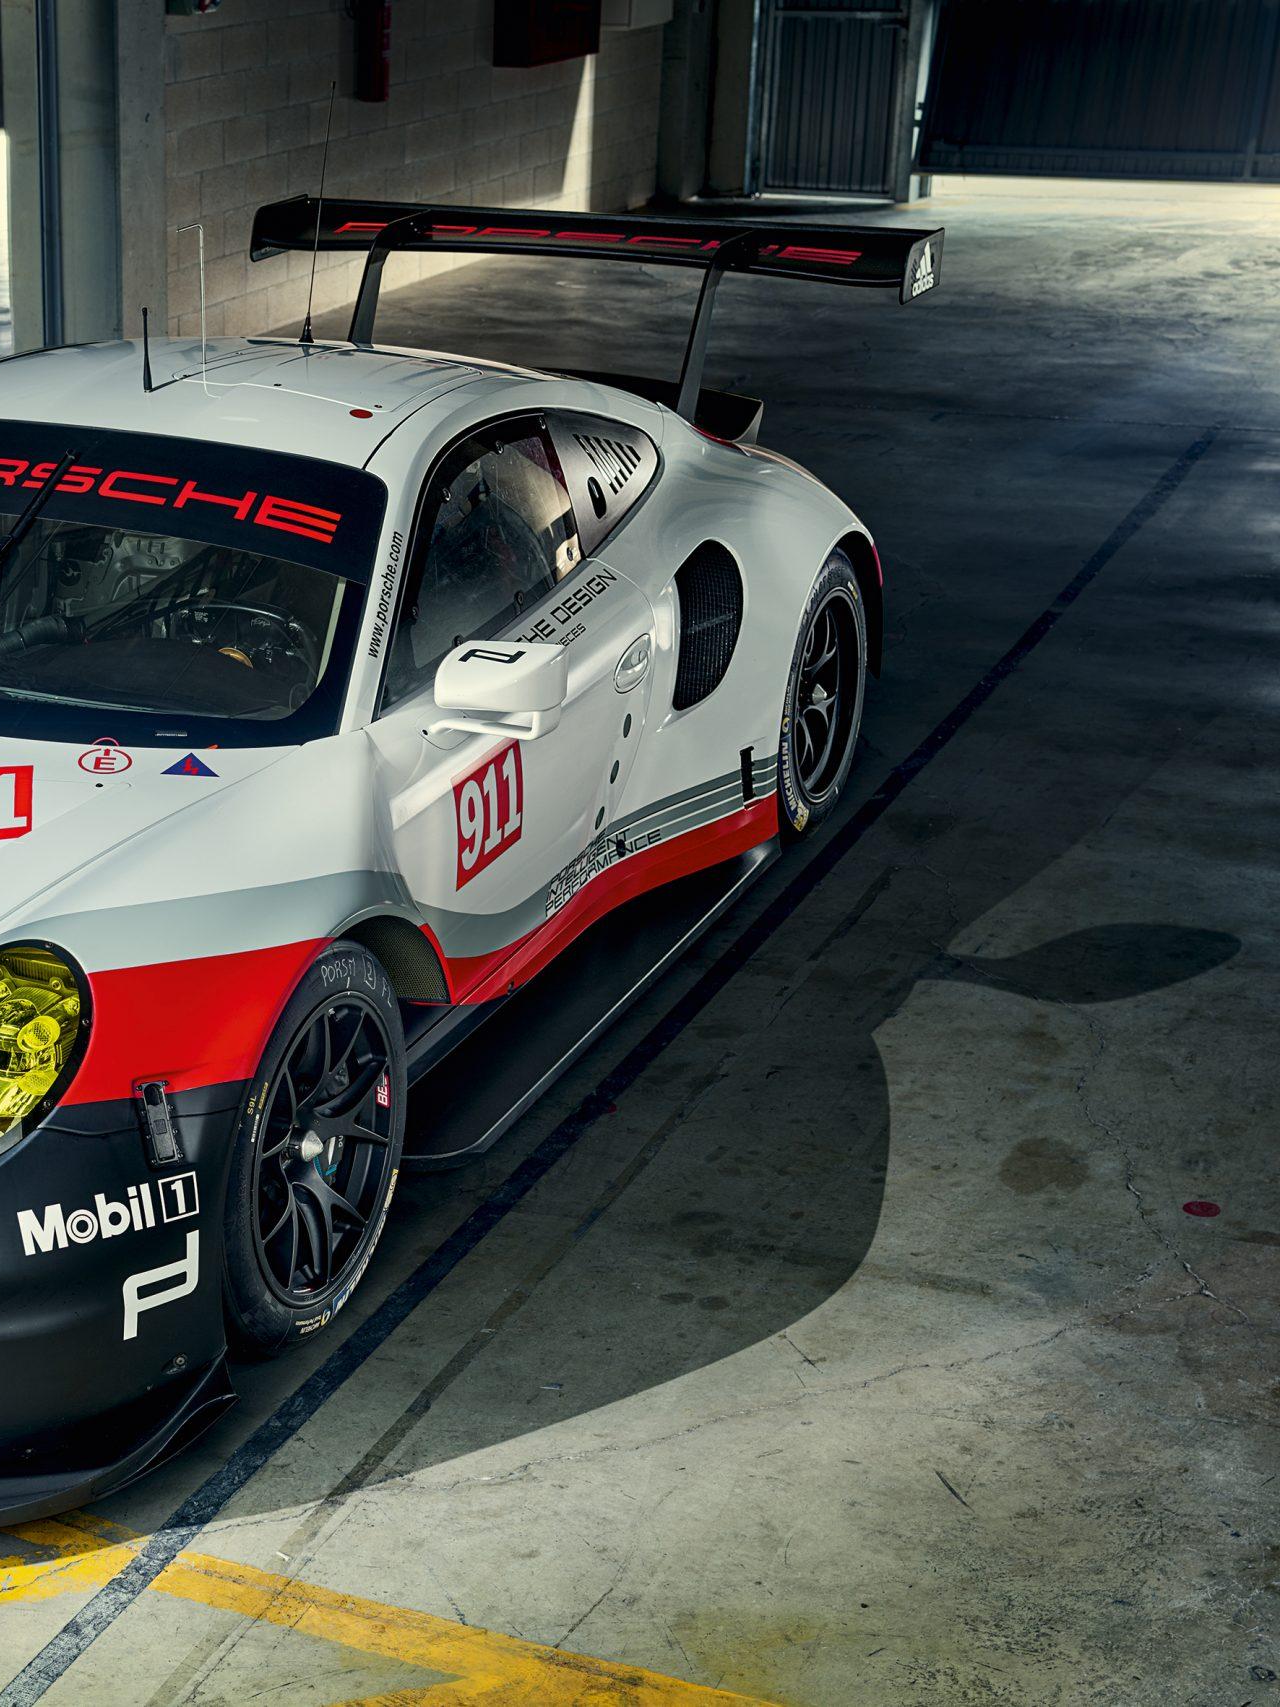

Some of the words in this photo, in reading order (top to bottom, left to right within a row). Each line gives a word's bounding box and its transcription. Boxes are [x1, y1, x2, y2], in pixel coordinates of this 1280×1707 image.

[333, 222, 862, 265] PORSCE
[912, 273, 934, 297] adidas
[368, 531, 404, 659] www.porsche.com
[550, 568, 617, 625] DESIGN
[459, 748, 521, 871] 911
[781, 742, 797, 811] MICHELIN
[17, 1182, 156, 1256] Mobil
